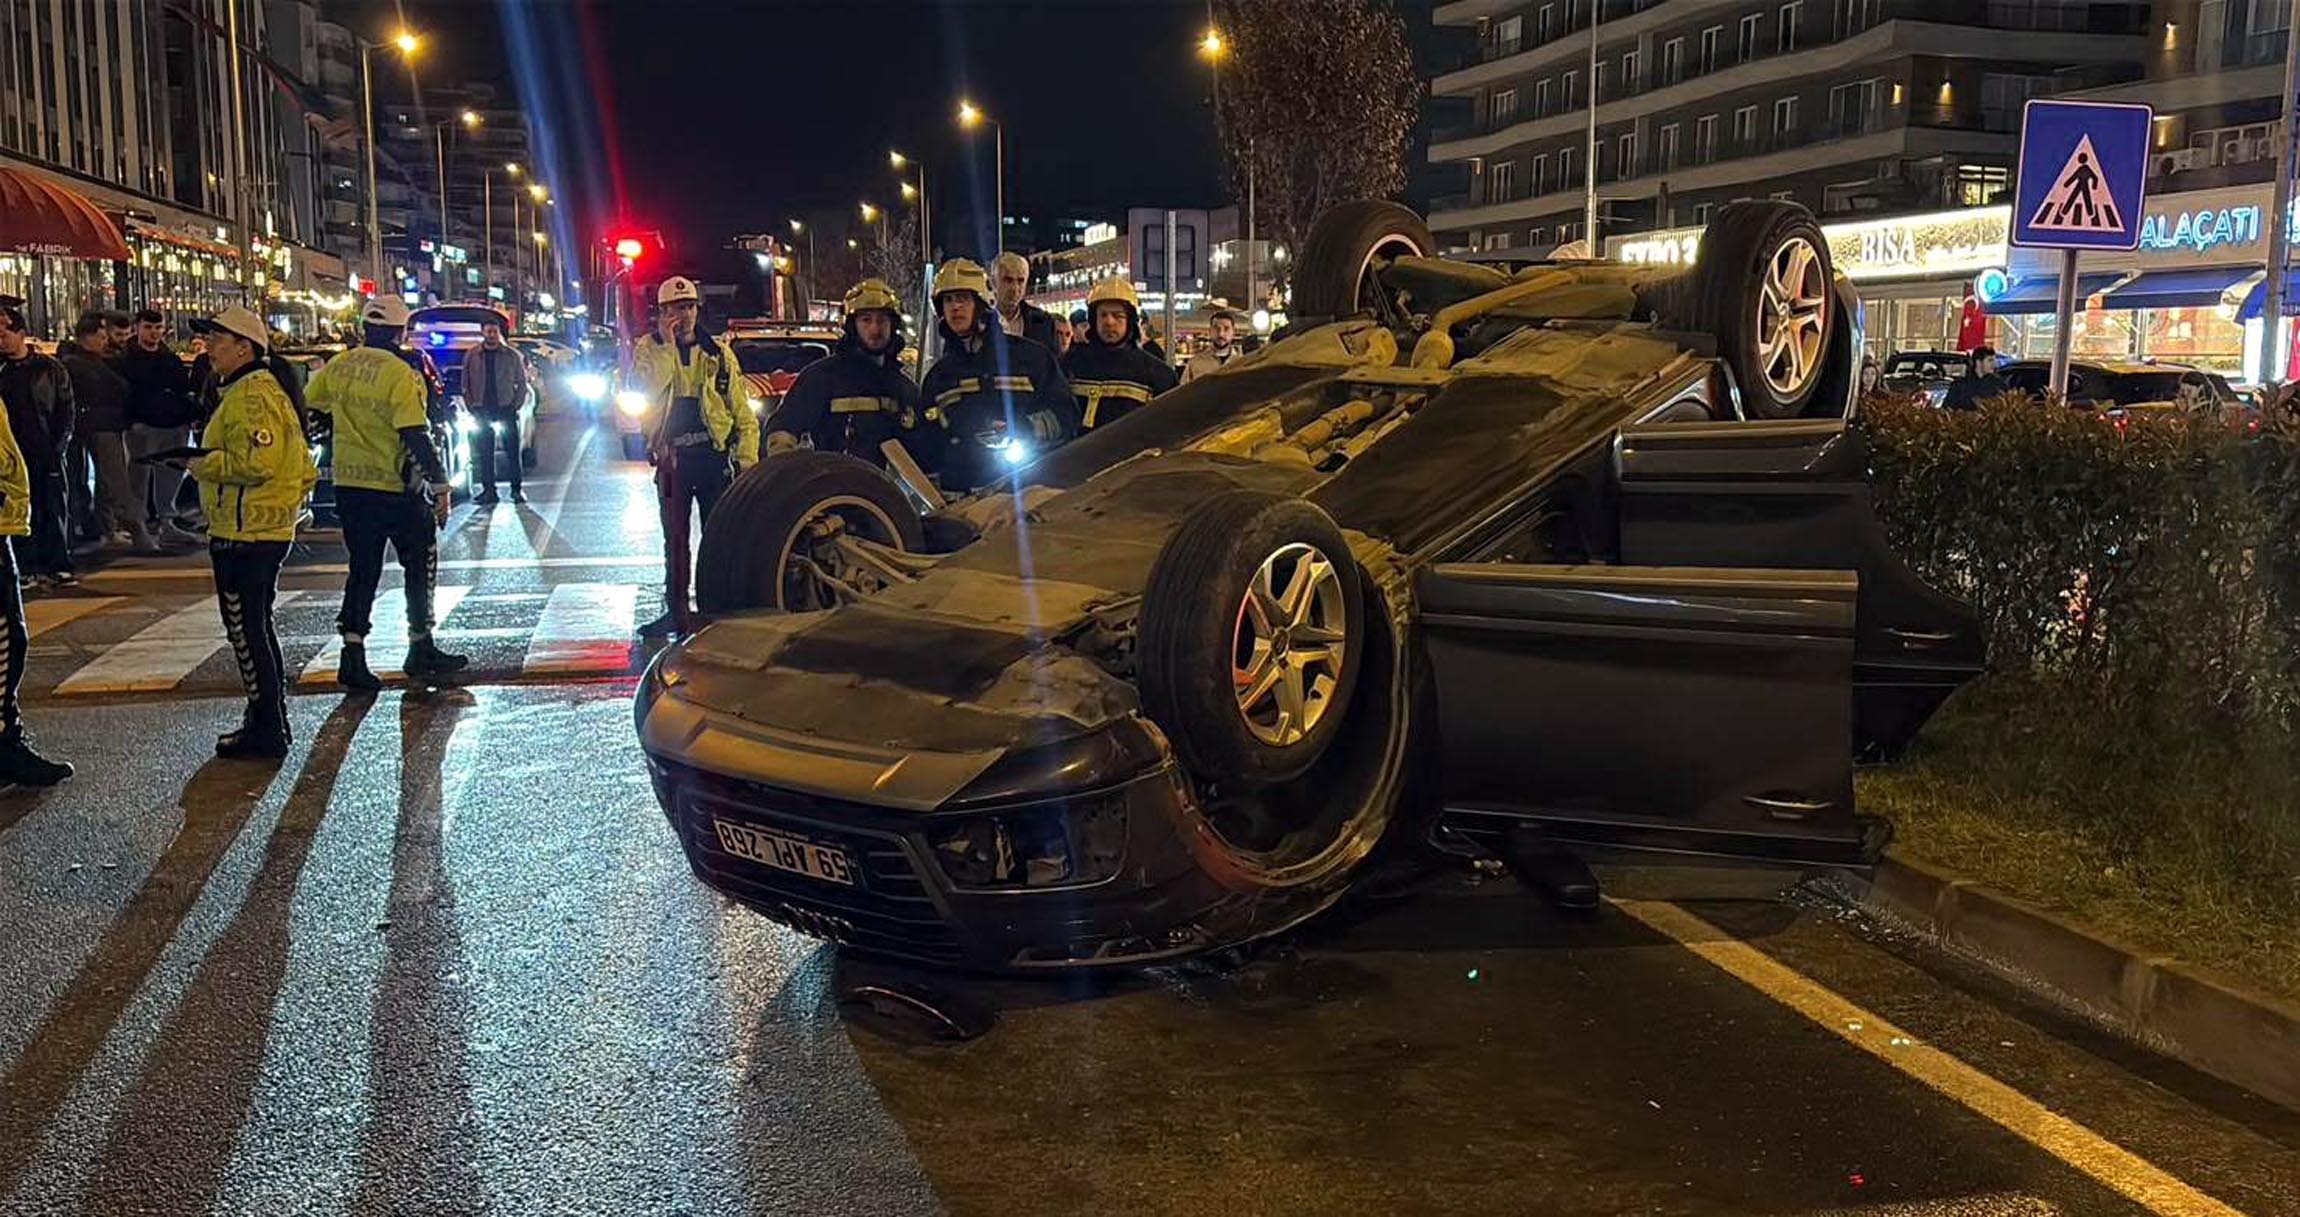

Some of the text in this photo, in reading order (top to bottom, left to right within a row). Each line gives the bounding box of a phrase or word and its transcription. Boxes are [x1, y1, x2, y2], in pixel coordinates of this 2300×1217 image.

[2139, 204, 2260, 251] ALAÇATI
[718, 823, 850, 882] 59 APL 268
